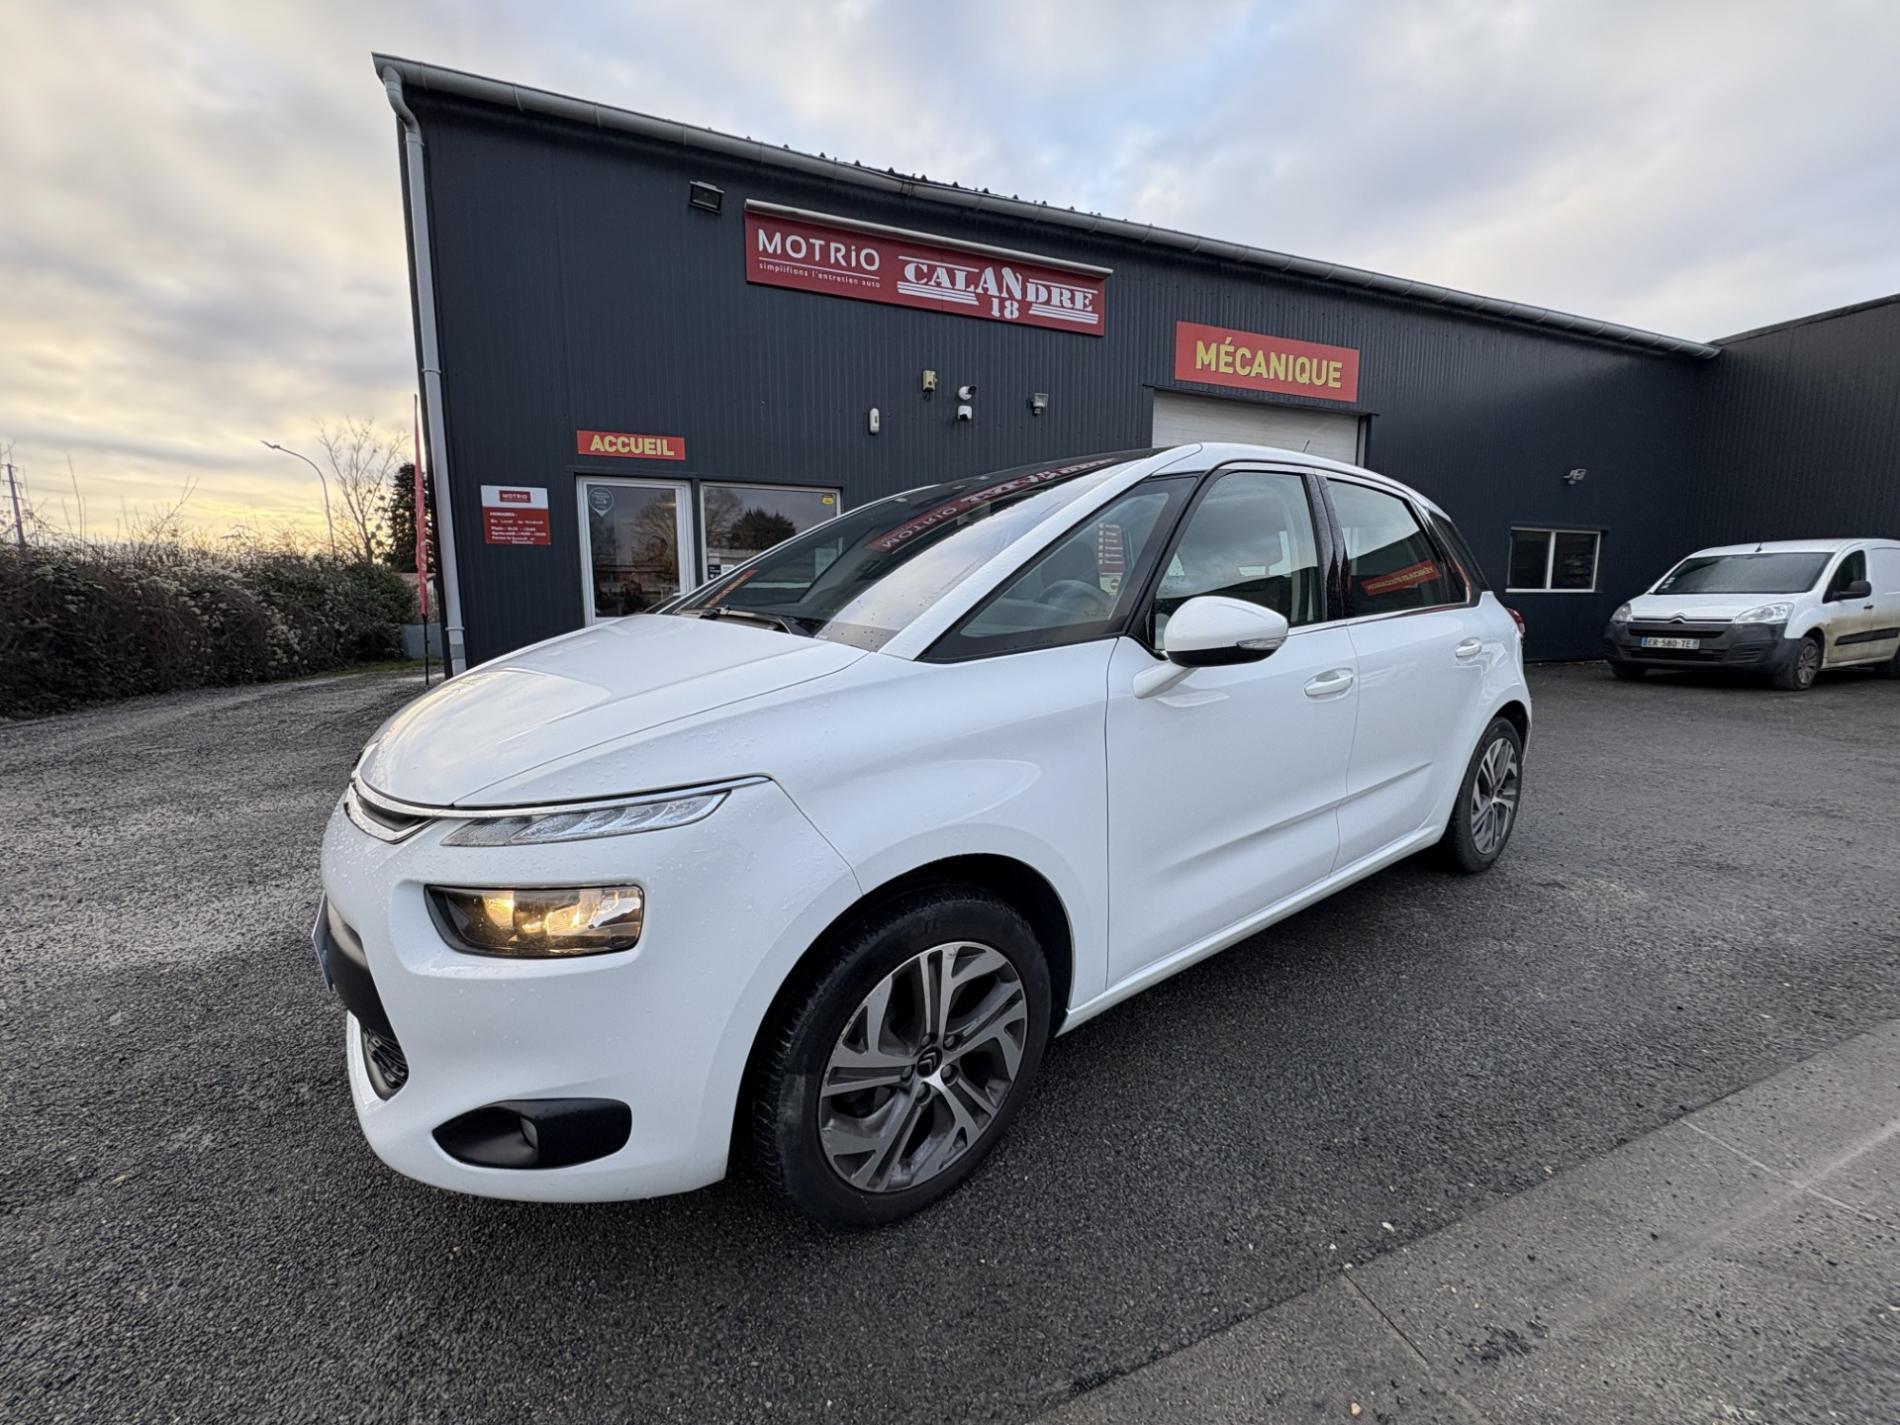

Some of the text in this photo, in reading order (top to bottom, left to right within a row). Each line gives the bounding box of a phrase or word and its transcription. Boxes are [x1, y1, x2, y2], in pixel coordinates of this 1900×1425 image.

[759, 262, 880, 288] simplifions l'entretien auto
[904, 262, 1092, 312] CALANDRE
[991, 297, 1019, 320] 18
[1196, 336, 1342, 388] MÉCANIQUE
[589, 434, 675, 456] ACCUEIL
